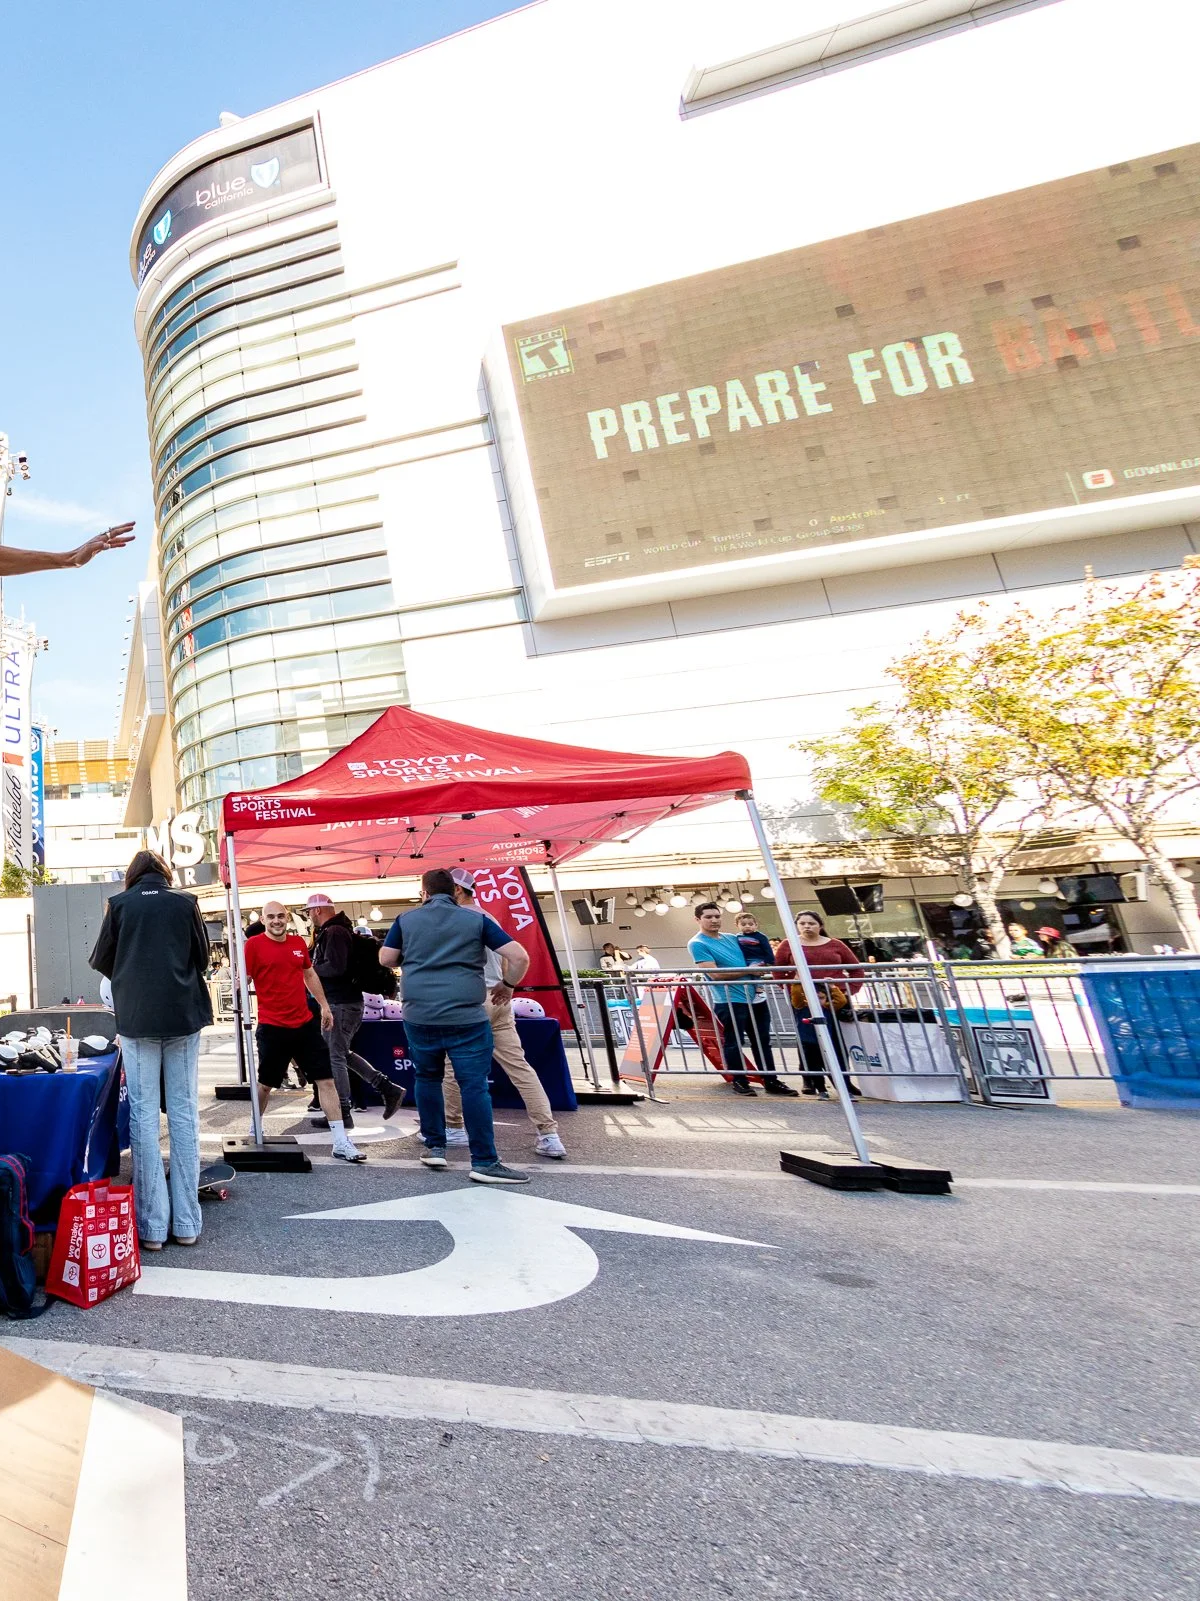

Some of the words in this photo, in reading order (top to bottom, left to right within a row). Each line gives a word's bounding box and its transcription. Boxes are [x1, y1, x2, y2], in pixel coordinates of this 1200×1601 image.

[195, 176, 247, 207] blue
[204, 187, 254, 210] california
[587, 361, 833, 460] PREPARE
[847, 331, 974, 405] FOR
[829, 508, 886, 523] Australia
[643, 543, 679, 555] WORLD
[584, 551, 631, 568] ESPN
[5, 650, 21, 745] ULTRA
[373, 753, 486, 769] TOYOTA
[352, 764, 453, 779] SPORTS
[401, 766, 533, 783] FESTIVAL
[232, 799, 282, 812] SPORTS
[255, 807, 316, 820] FESTIVAL
[497, 866, 534, 931] YOTA
